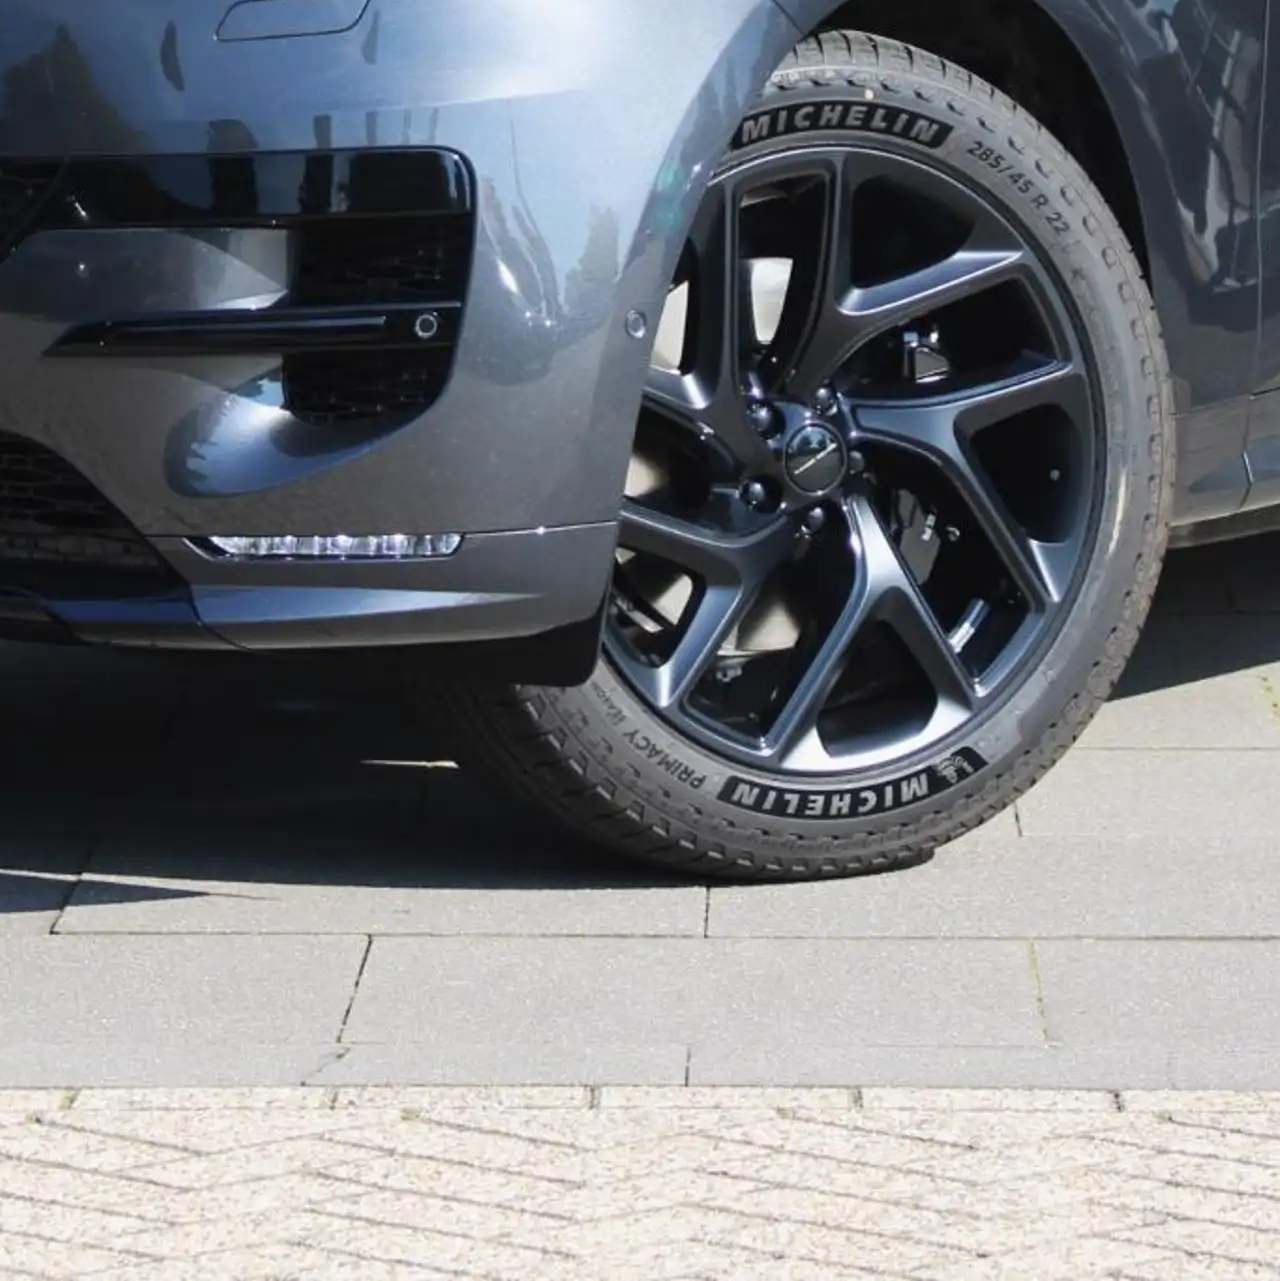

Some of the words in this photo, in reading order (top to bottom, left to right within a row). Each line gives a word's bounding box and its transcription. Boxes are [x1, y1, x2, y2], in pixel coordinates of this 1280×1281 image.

[740, 104, 940, 144] MICHELIN
[966, 139, 1035, 194] 285/45
[1031, 193, 1050, 211] R
[1044, 211, 1070, 236] 22
[622, 727, 708, 790] PRIMACY
[730, 773, 929, 817] MICHELIN
